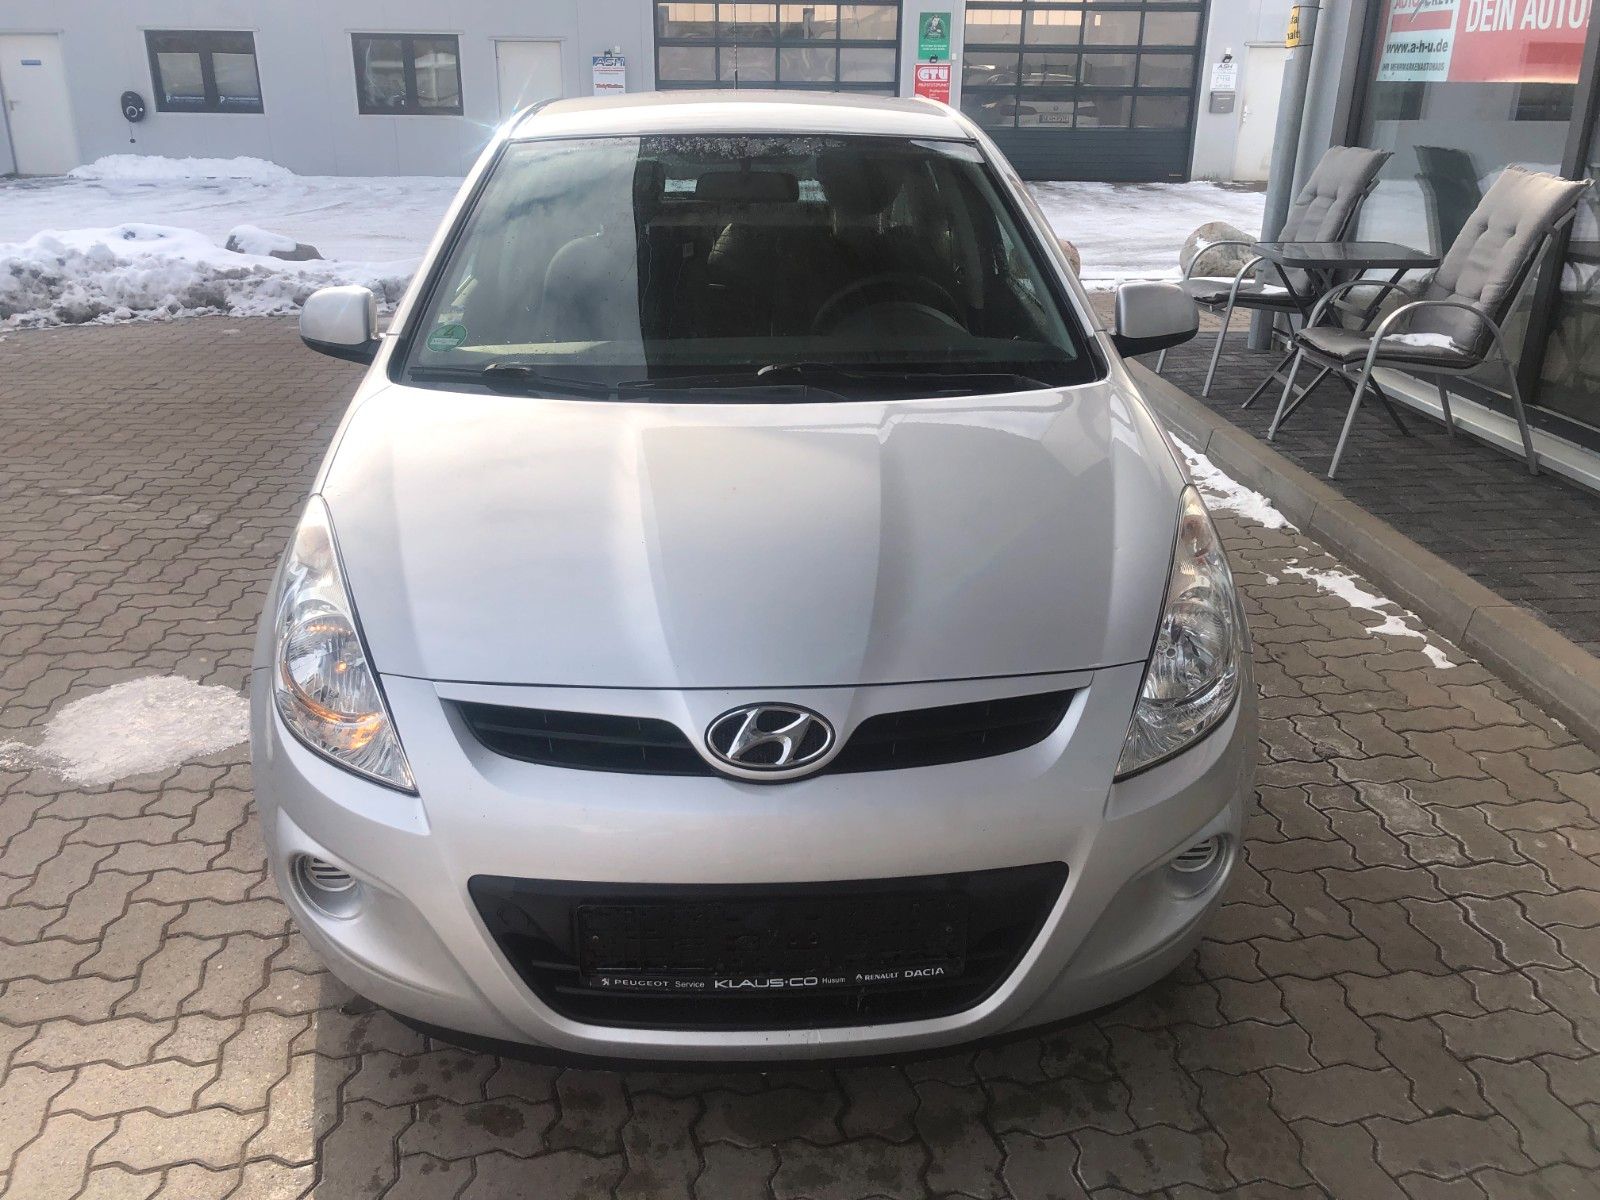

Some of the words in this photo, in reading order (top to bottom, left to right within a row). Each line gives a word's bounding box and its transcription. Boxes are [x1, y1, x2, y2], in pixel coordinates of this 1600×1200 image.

[1465, 0, 1516, 32] DEIN
[1386, 39, 1449, 54] www.a-h-u.de
[614, 979, 669, 987] PEUGEOT
[675, 980, 705, 988] Service
[865, 972, 898, 981] RENAULT
[905, 967, 944, 978] DACIA
